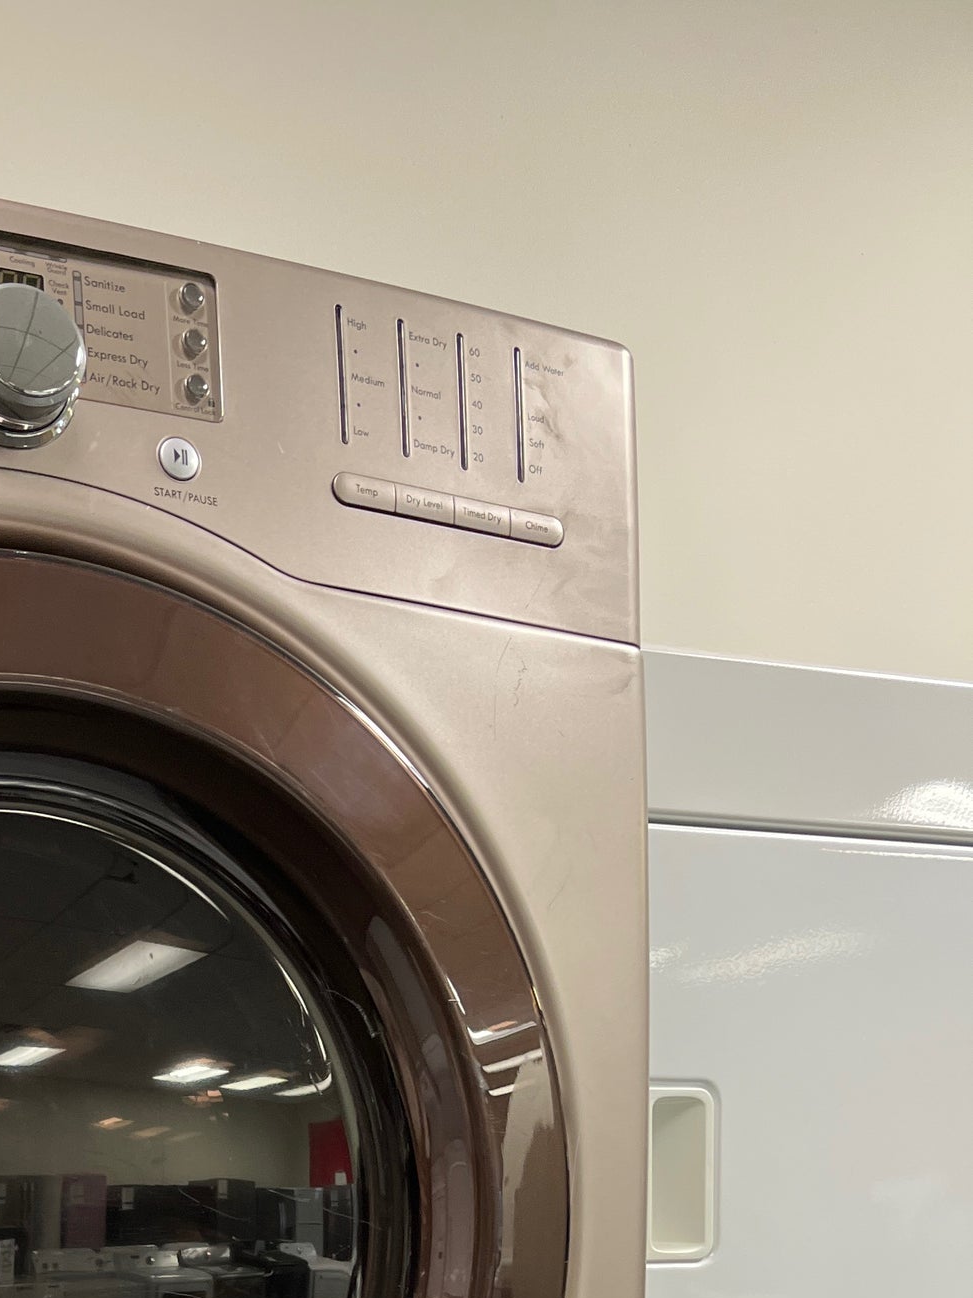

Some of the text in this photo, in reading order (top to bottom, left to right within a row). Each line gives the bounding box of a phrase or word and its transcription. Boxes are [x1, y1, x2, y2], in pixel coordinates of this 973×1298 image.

[84, 276, 125, 293] Sanitize
[86, 300, 146, 320] Small Load
[347, 317, 367, 331] High
[86, 323, 134, 341] Delicates
[409, 331, 447, 350] Extra Dry
[87, 347, 148, 369] Express Dry
[469, 347, 481, 358] 60
[524, 360, 540, 372] Add
[90, 372, 161, 395] Air/Rack Dry
[351, 373, 385, 388] Medium
[470, 373, 482, 384] 50
[411, 385, 442, 401] Normal
[471, 400, 483, 410] 40
[527, 412, 545, 424] Loud
[353, 426, 369, 437] Low
[472, 424, 483, 436] 30
[413, 439, 455, 459] Damp Dry
[529, 438, 545, 449] Soft
[473, 452, 484, 463] 20
[528, 464, 543, 475] Off
[154, 486, 218, 507] START/PAUSE
[356, 483, 378, 497] Temp
[406, 494, 443, 510] Dry Level
[463, 506, 502, 525] Timed Dry
[525, 520, 549, 534] Chime
